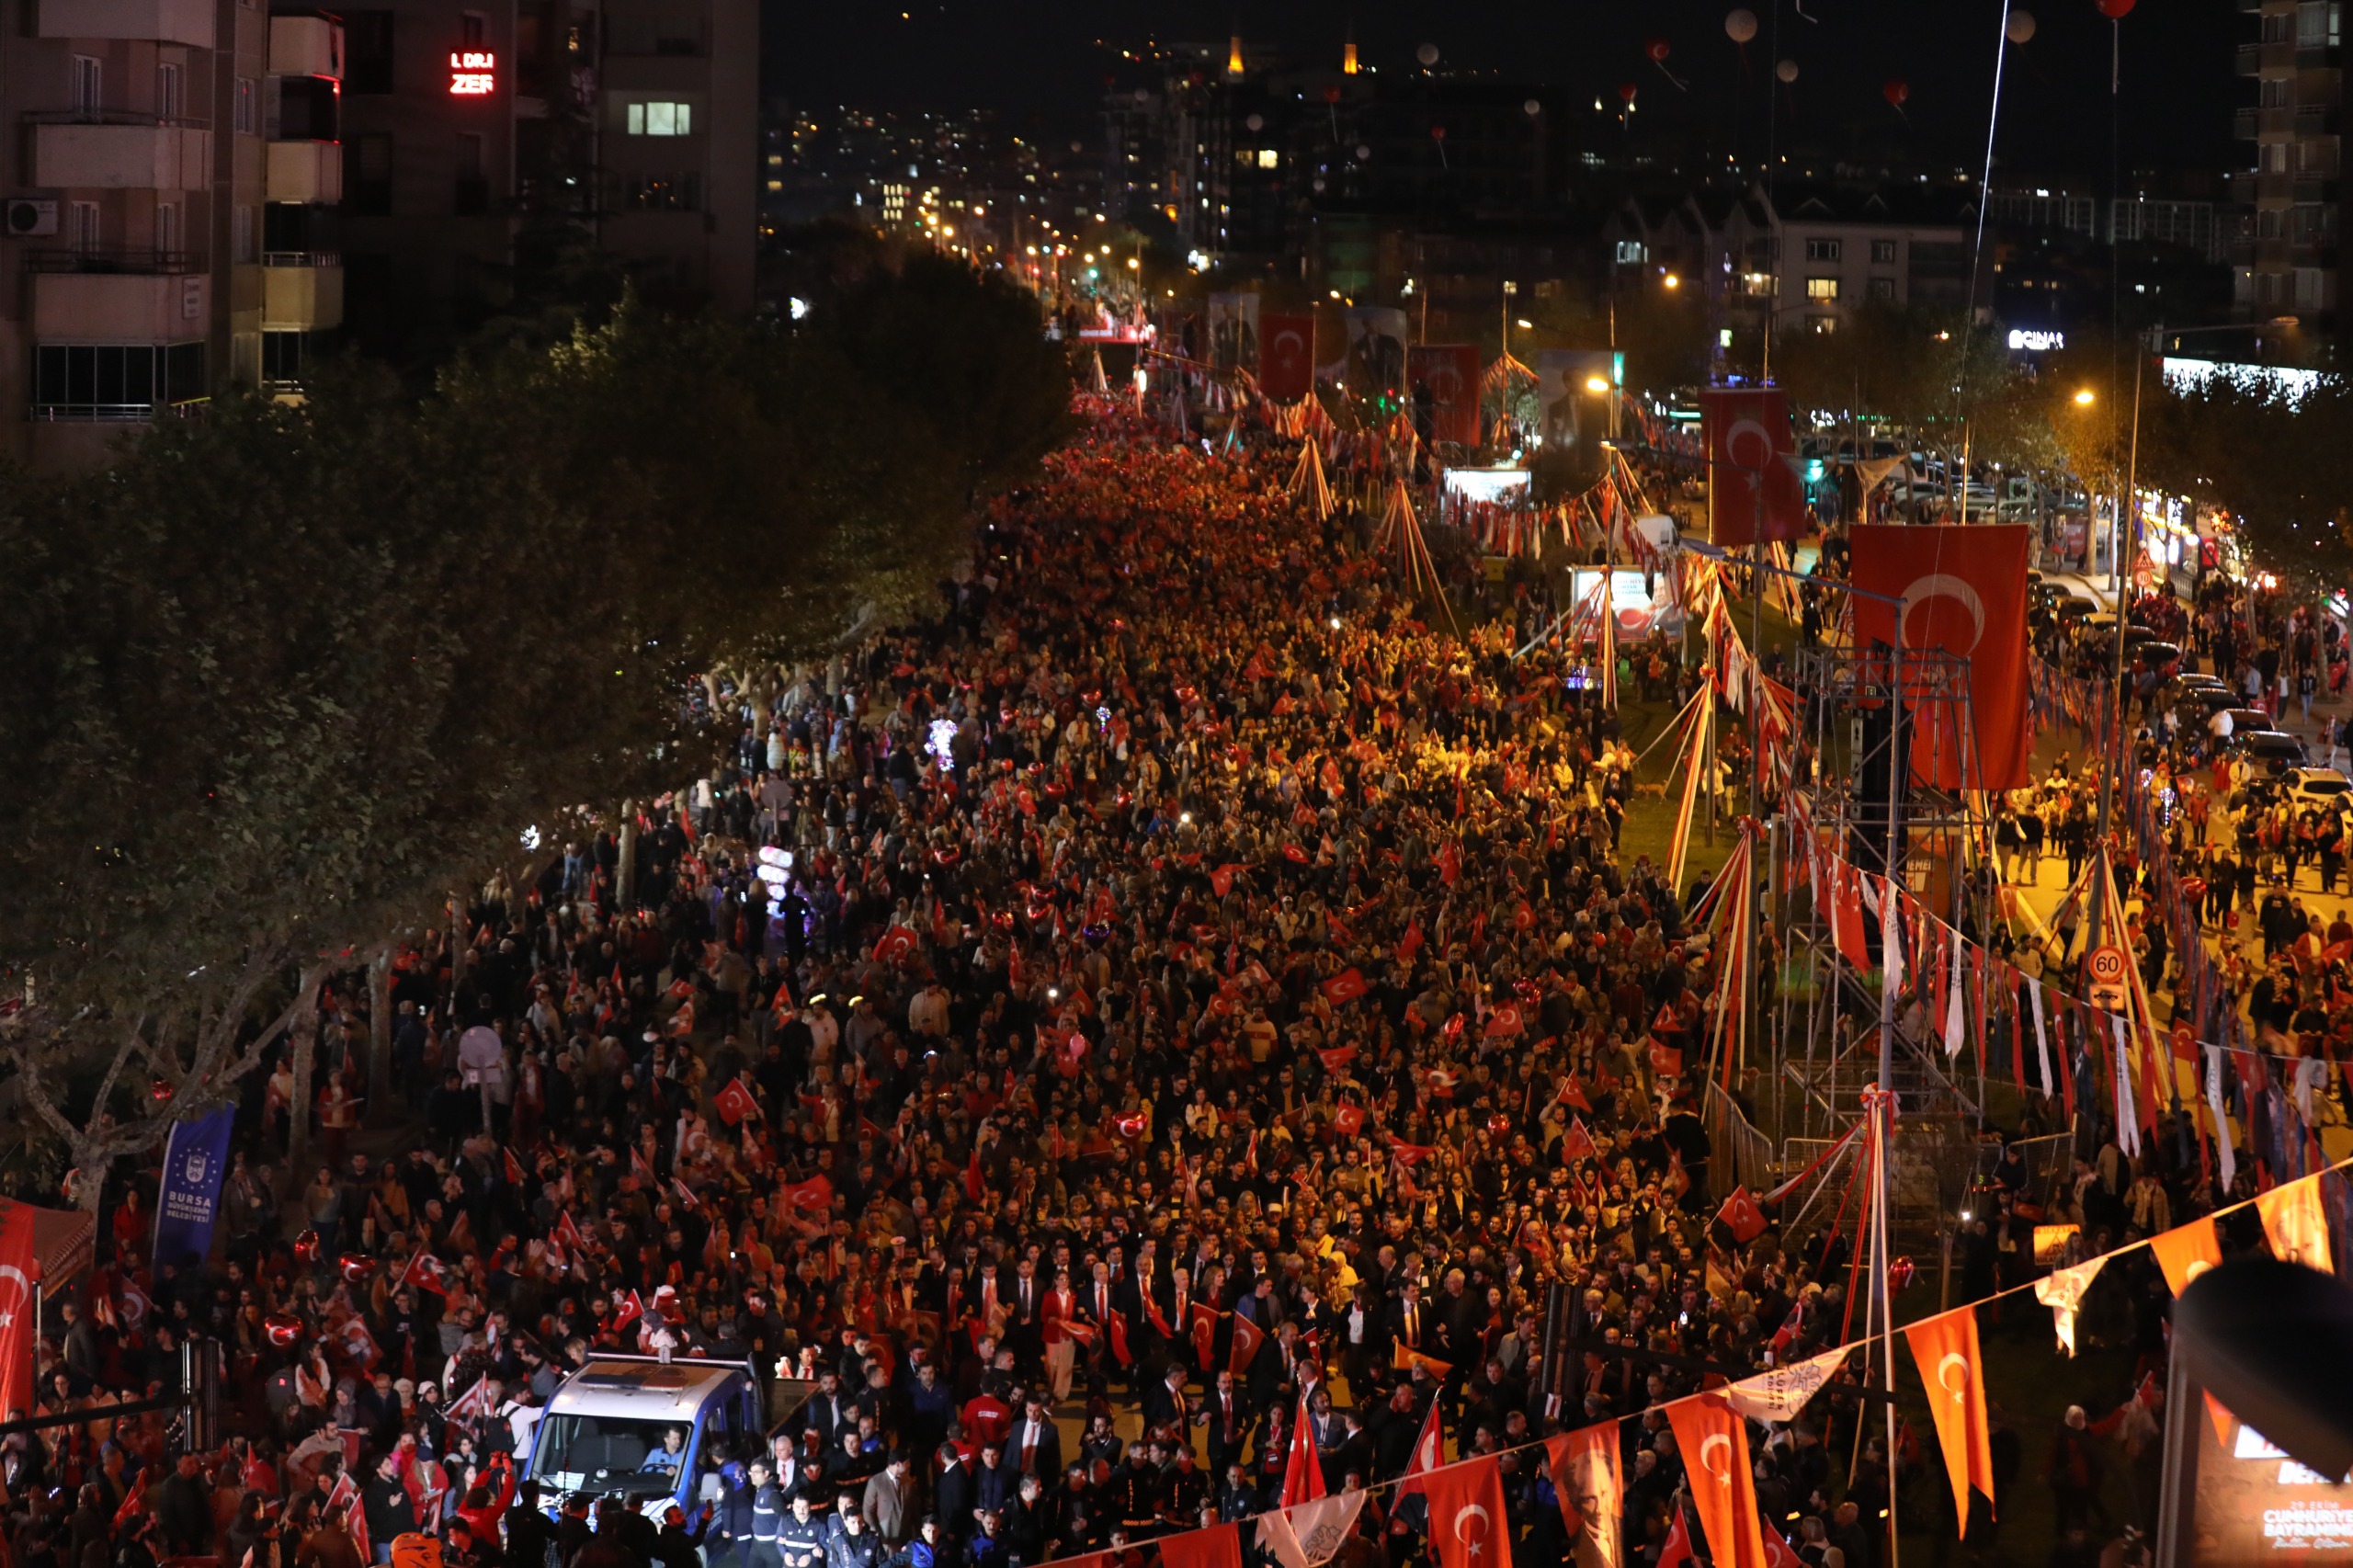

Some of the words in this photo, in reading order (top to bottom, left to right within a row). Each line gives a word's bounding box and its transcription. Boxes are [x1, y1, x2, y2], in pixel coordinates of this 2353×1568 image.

[2139, 574, 2149, 582] 30
[2096, 956, 2119, 972] 60
[169, 1191, 211, 1208] BURSA
